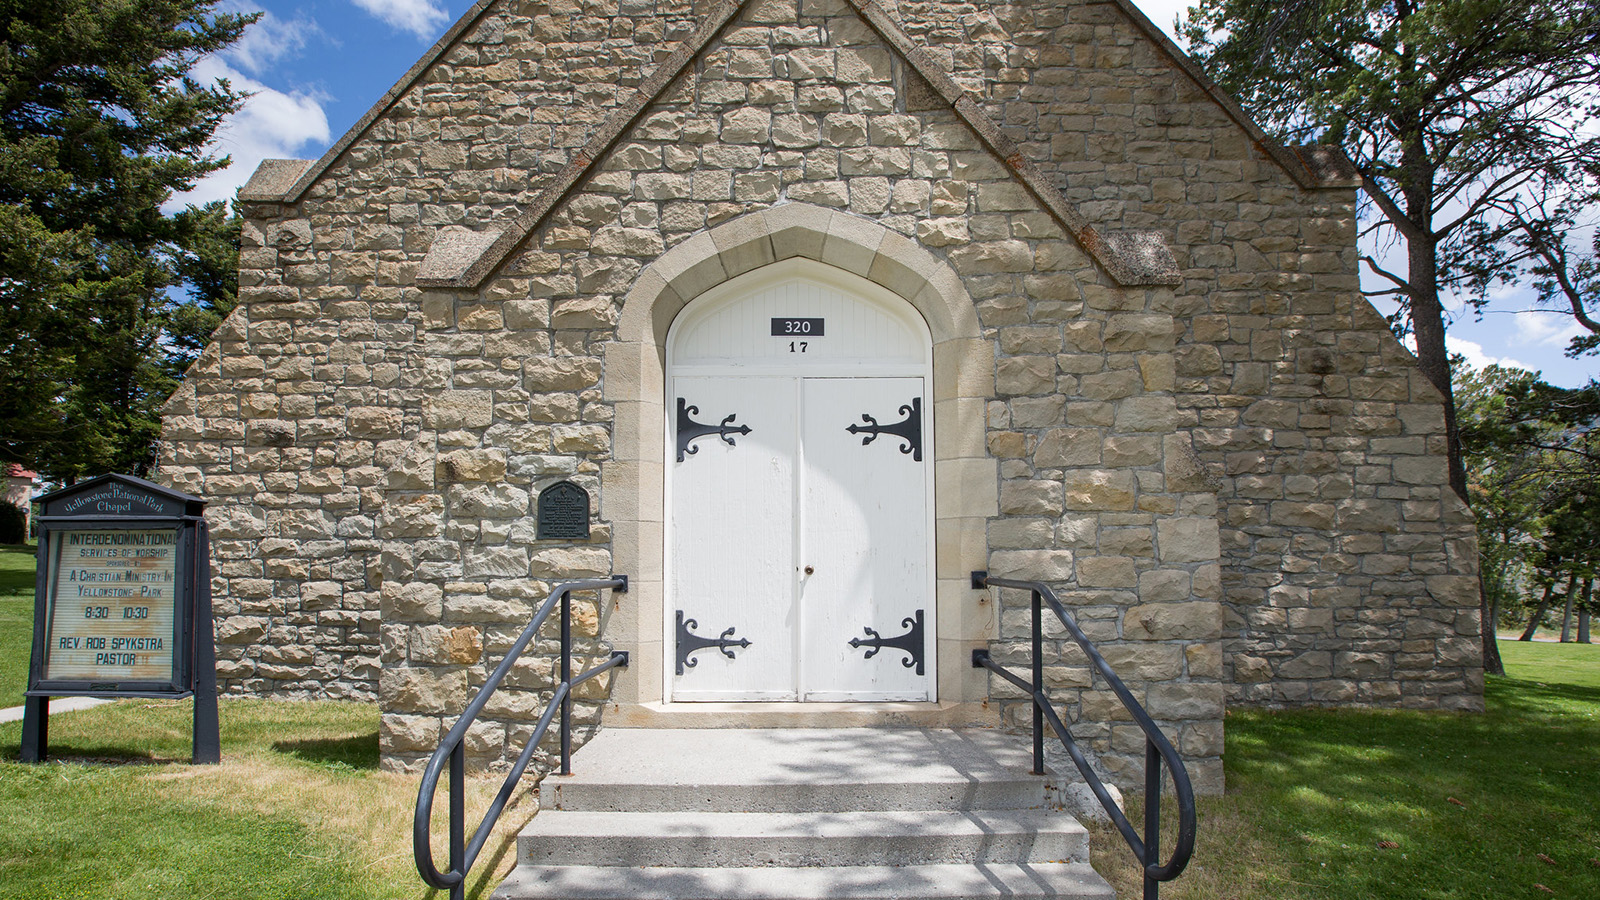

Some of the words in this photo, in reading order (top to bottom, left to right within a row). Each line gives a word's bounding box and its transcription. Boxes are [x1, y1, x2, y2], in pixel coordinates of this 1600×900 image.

[784, 321, 811, 333] 320
[789, 341, 808, 353] 17
[108, 482, 124, 490] The
[64, 491, 112, 513] Yellowstone
[112, 488, 148, 505] National
[146, 496, 164, 513] Park
[97, 501, 131, 513] Chapel
[69, 533, 177, 545] INTERDENOMINATIONAL
[80, 548, 117, 557] SERVICES
[121, 548, 132, 557] OF
[135, 548, 168, 558] WORSHIP
[70, 570, 77, 581] A
[78, 585, 133, 598] YELLOWSTONE
[141, 585, 162, 598] PARK
[85, 606, 109, 619] 8:30
[123, 606, 148, 619] 10:30
[86, 637, 106, 649] ROB
[111, 637, 163, 650] SPYKSTRA
[96, 653, 136, 665] PASTOR
